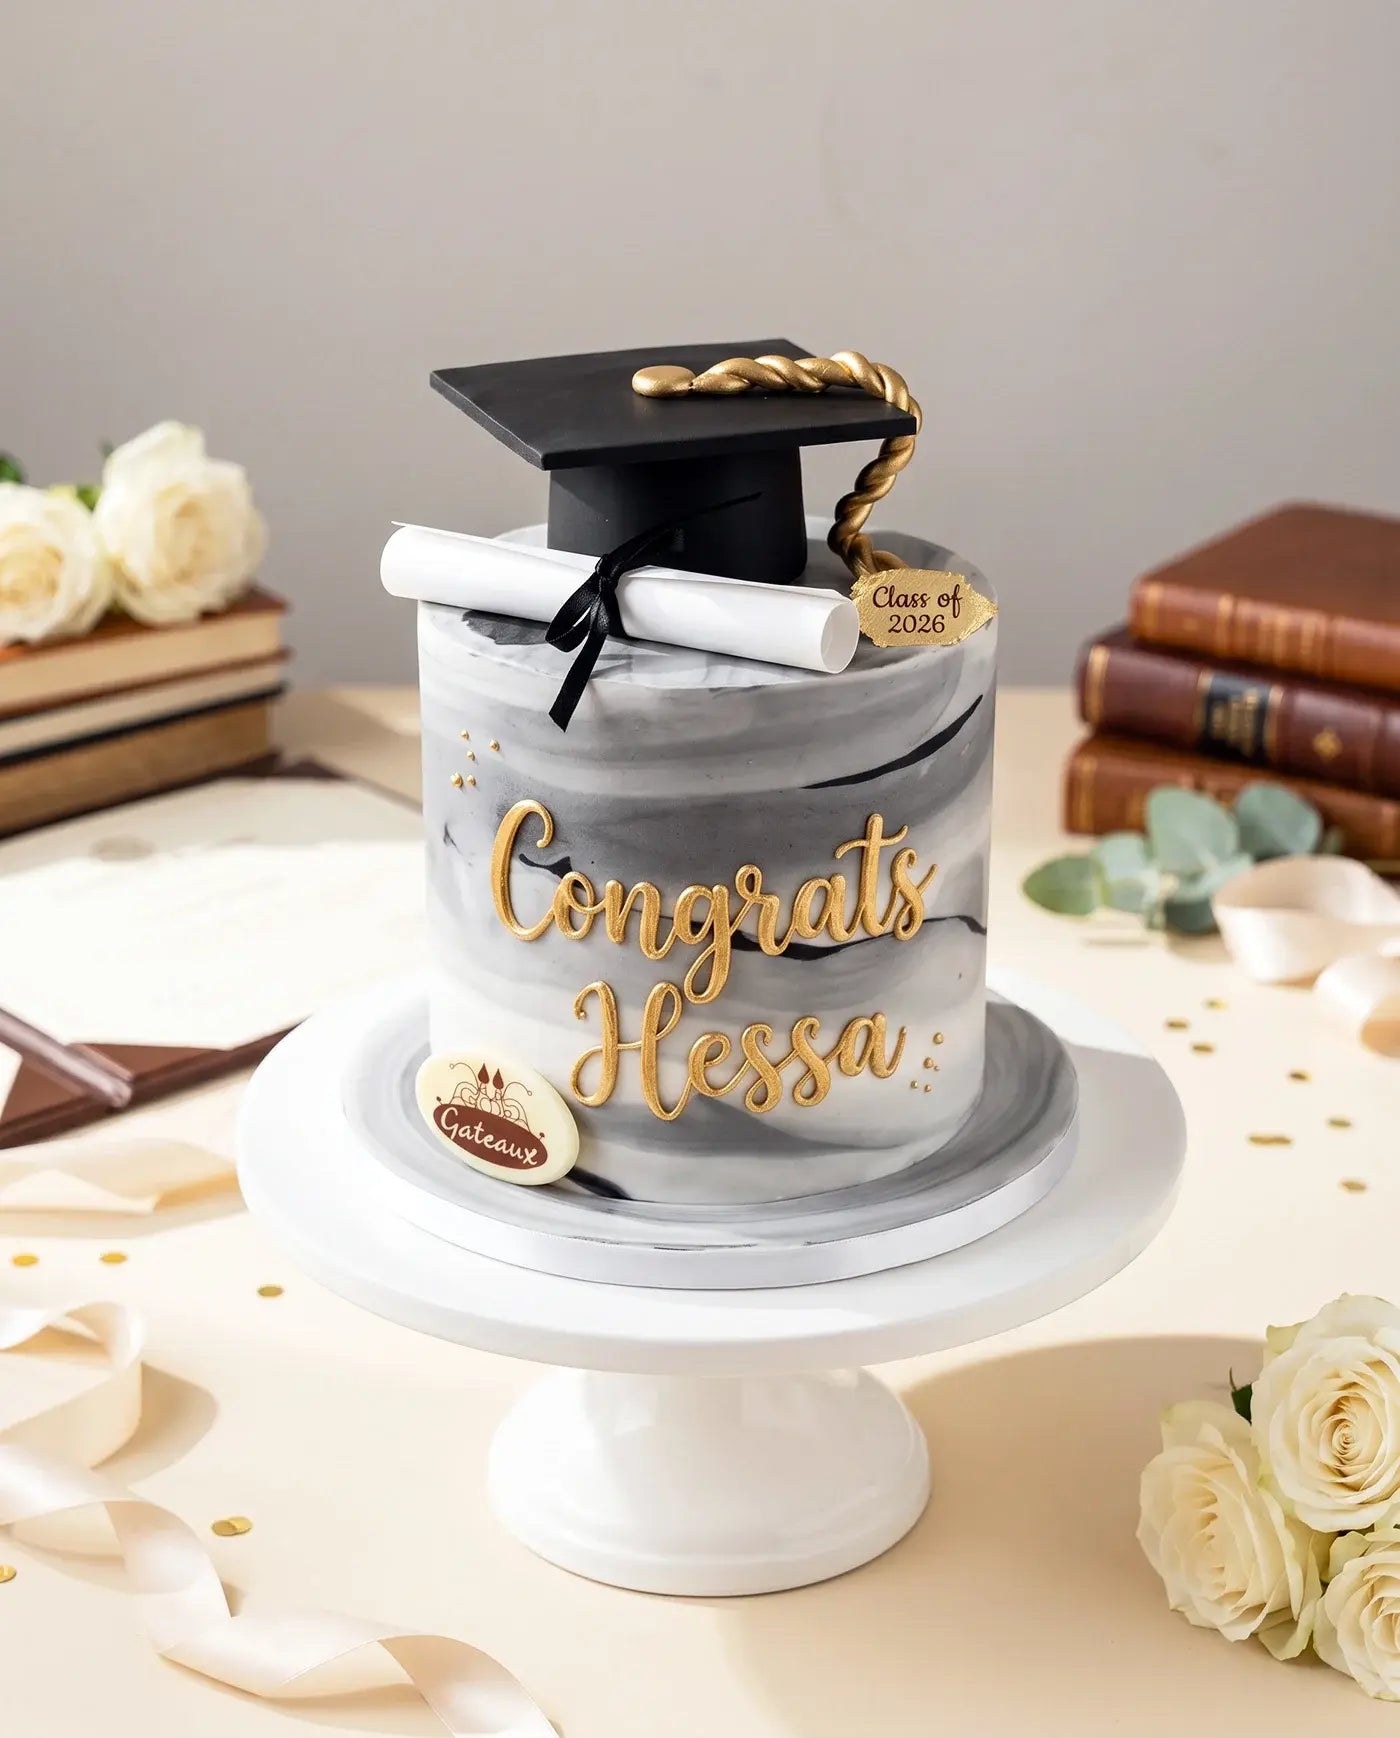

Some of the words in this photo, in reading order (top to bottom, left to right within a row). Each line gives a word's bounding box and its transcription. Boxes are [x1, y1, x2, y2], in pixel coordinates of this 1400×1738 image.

[872, 584, 931, 608] Class
[937, 583, 963, 619] of
[888, 614, 946, 634] 2026
[490, 799, 939, 1005] Congrats
[569, 980, 907, 1122] Hessa
[440, 1106, 539, 1166] Gateaux
